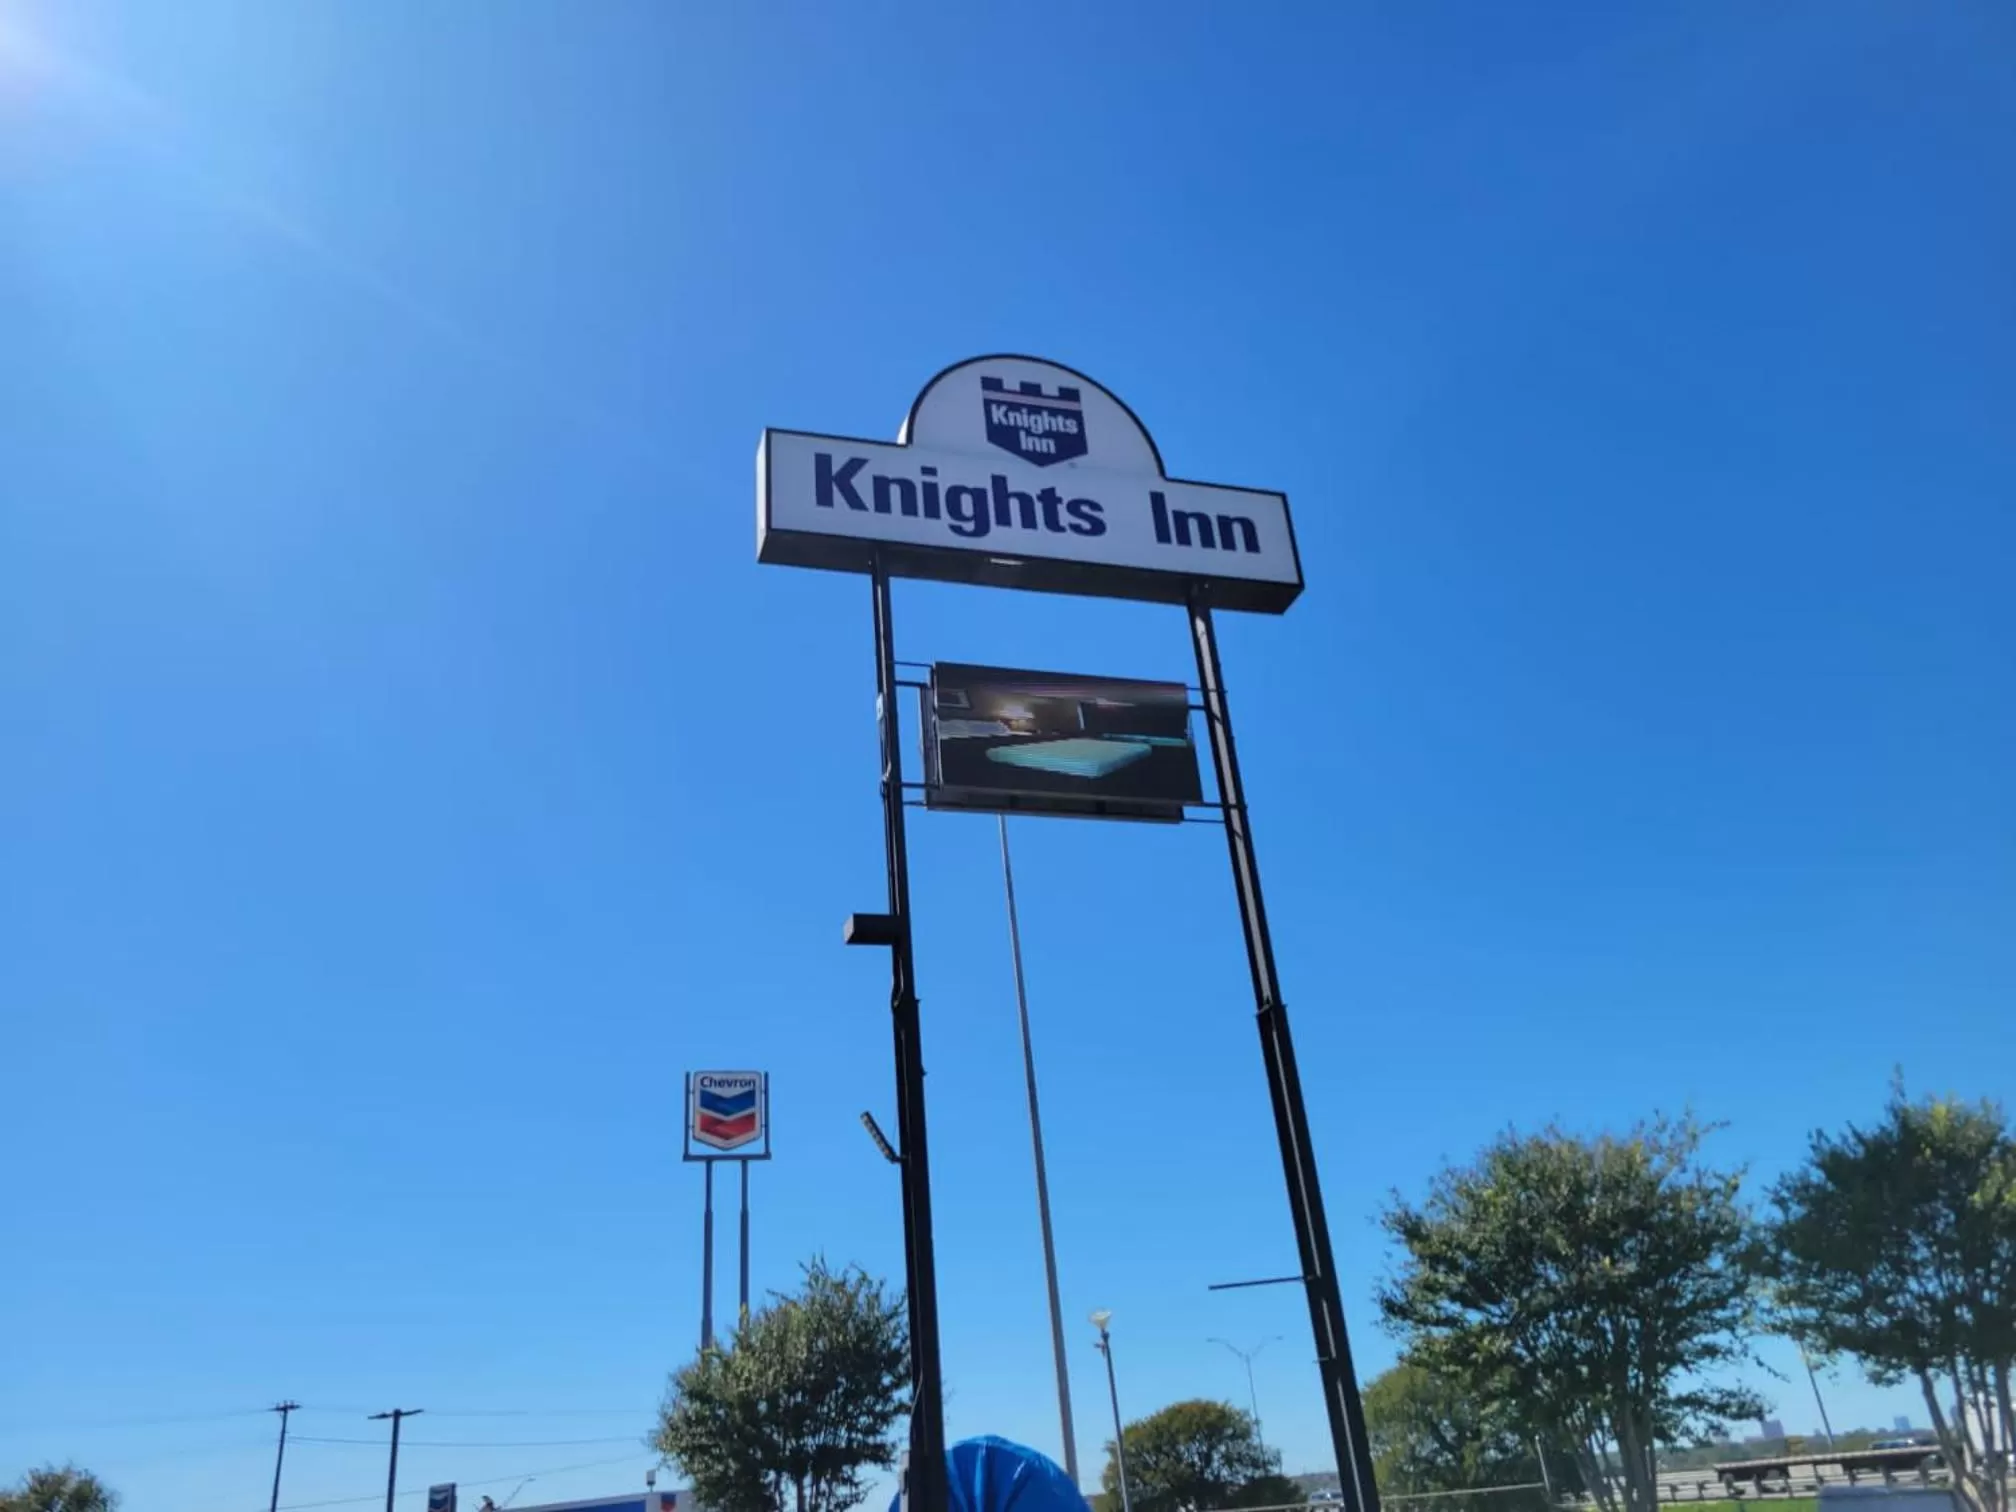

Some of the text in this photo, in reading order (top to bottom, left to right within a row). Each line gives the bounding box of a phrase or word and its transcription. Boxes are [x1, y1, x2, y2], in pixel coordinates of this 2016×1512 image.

[991, 404, 1078, 435] Knights
[1019, 429, 1056, 454] Inn
[814, 452, 1262, 553] Knights Inn
[700, 1076, 756, 1089] Chevron
